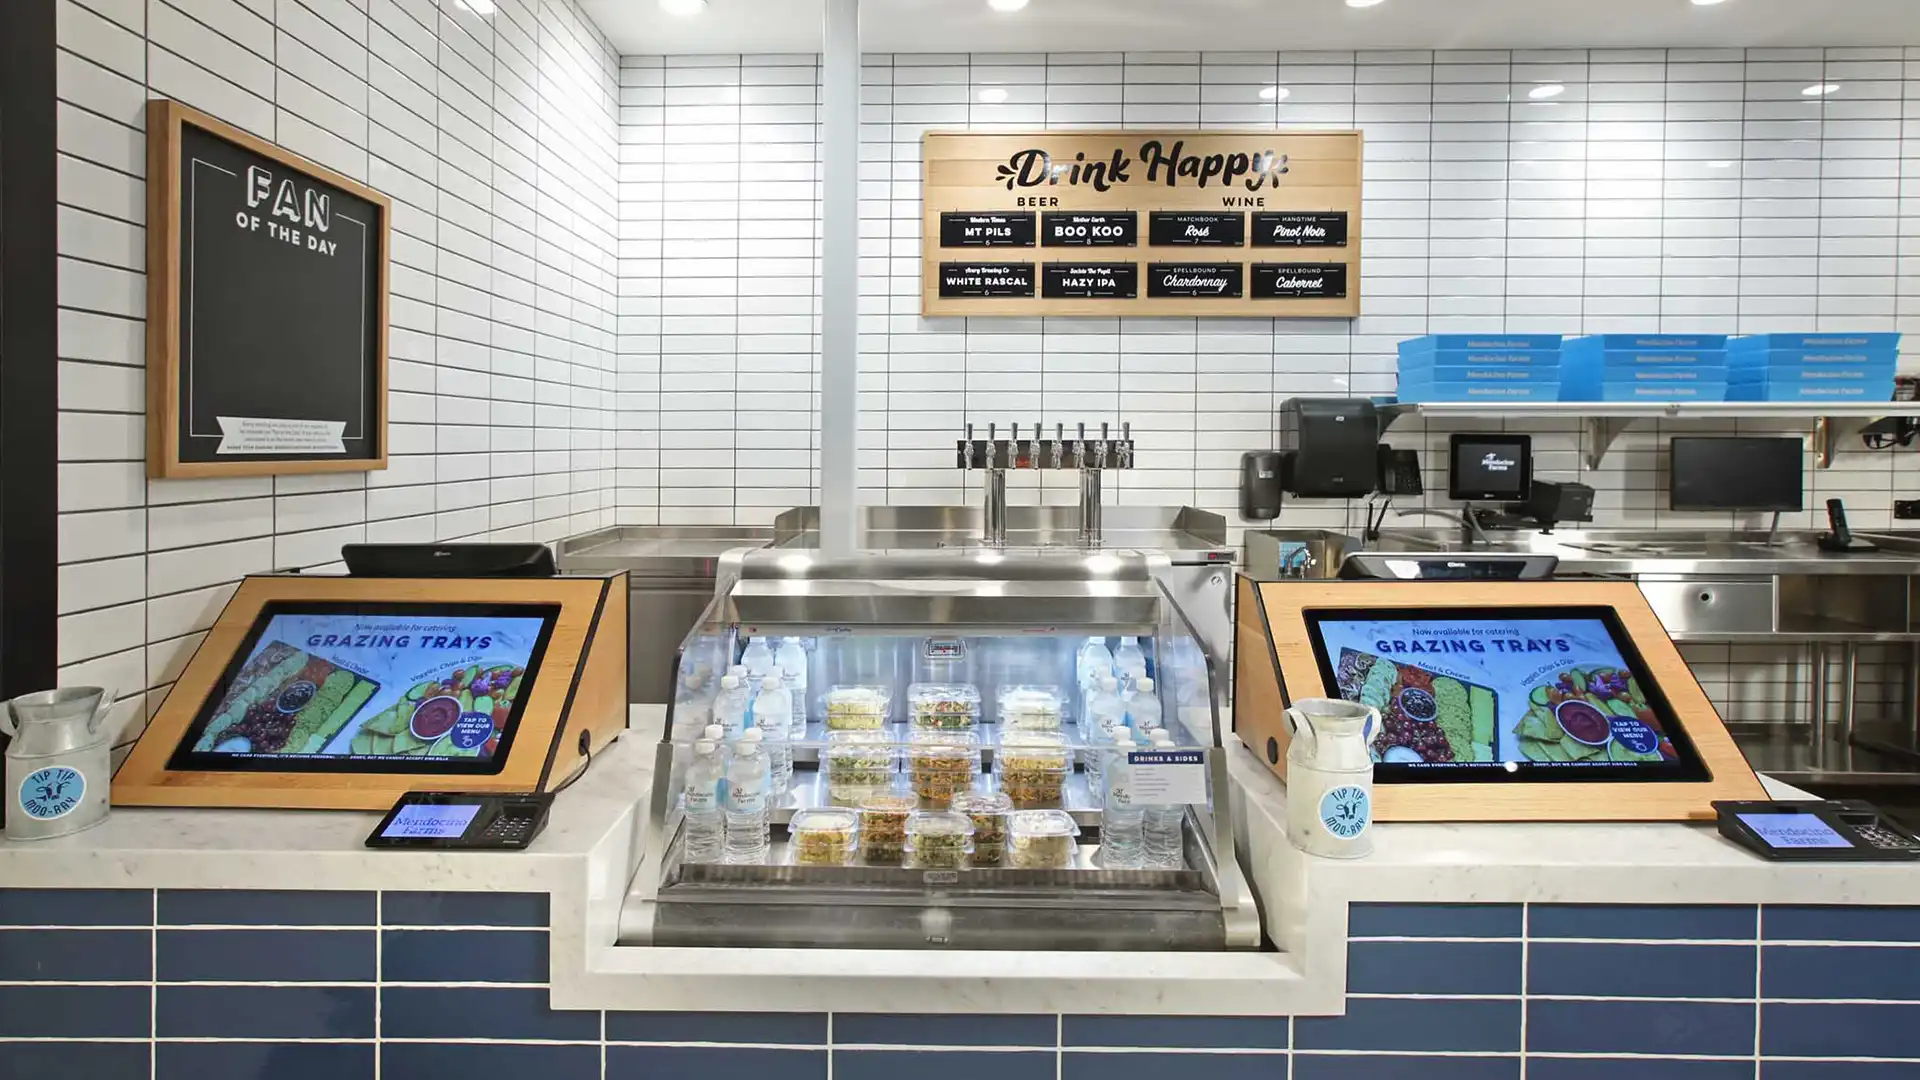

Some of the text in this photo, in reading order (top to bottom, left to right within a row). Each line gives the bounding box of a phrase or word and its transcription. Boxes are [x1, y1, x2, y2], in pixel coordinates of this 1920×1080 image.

[1010, 141, 1274, 192] Drink Happy
[247, 165, 330, 232] FAN
[1017, 197, 1059, 207] BEER
[1222, 197, 1265, 207] WINE
[236, 212, 337, 256] OF THE DAY
[964, 228, 1012, 236] MT PILS
[1054, 226, 1123, 236] BOO KOO
[1272, 224, 1326, 236] Pinot Noir
[946, 278, 1028, 286] WHITE RASCAL
[1062, 278, 1116, 286] HAZY IPA
[1163, 274, 1228, 292] Chardonnay
[1276, 276, 1323, 288] Cabernet
[423, 624, 457, 632] catering
[1472, 628, 1484, 636] for
[1484, 628, 1520, 636] catering
[307, 634, 492, 650] GRAZING TRAYS
[1376, 639, 1570, 653] GRAZING TRAYS
[1418, 661, 1436, 670] Meat
[32, 770, 76, 783] TIP TIP
[1331, 788, 1365, 801] TIP TIP
[24, 796, 77, 816] MOO-RAY
[394, 818, 468, 827] Mendocino
[1324, 816, 1365, 836] MOO-RAY
[402, 826, 445, 835] Farms
[1756, 826, 1836, 836] Mendocino
[1783, 836, 1830, 845] Farms
